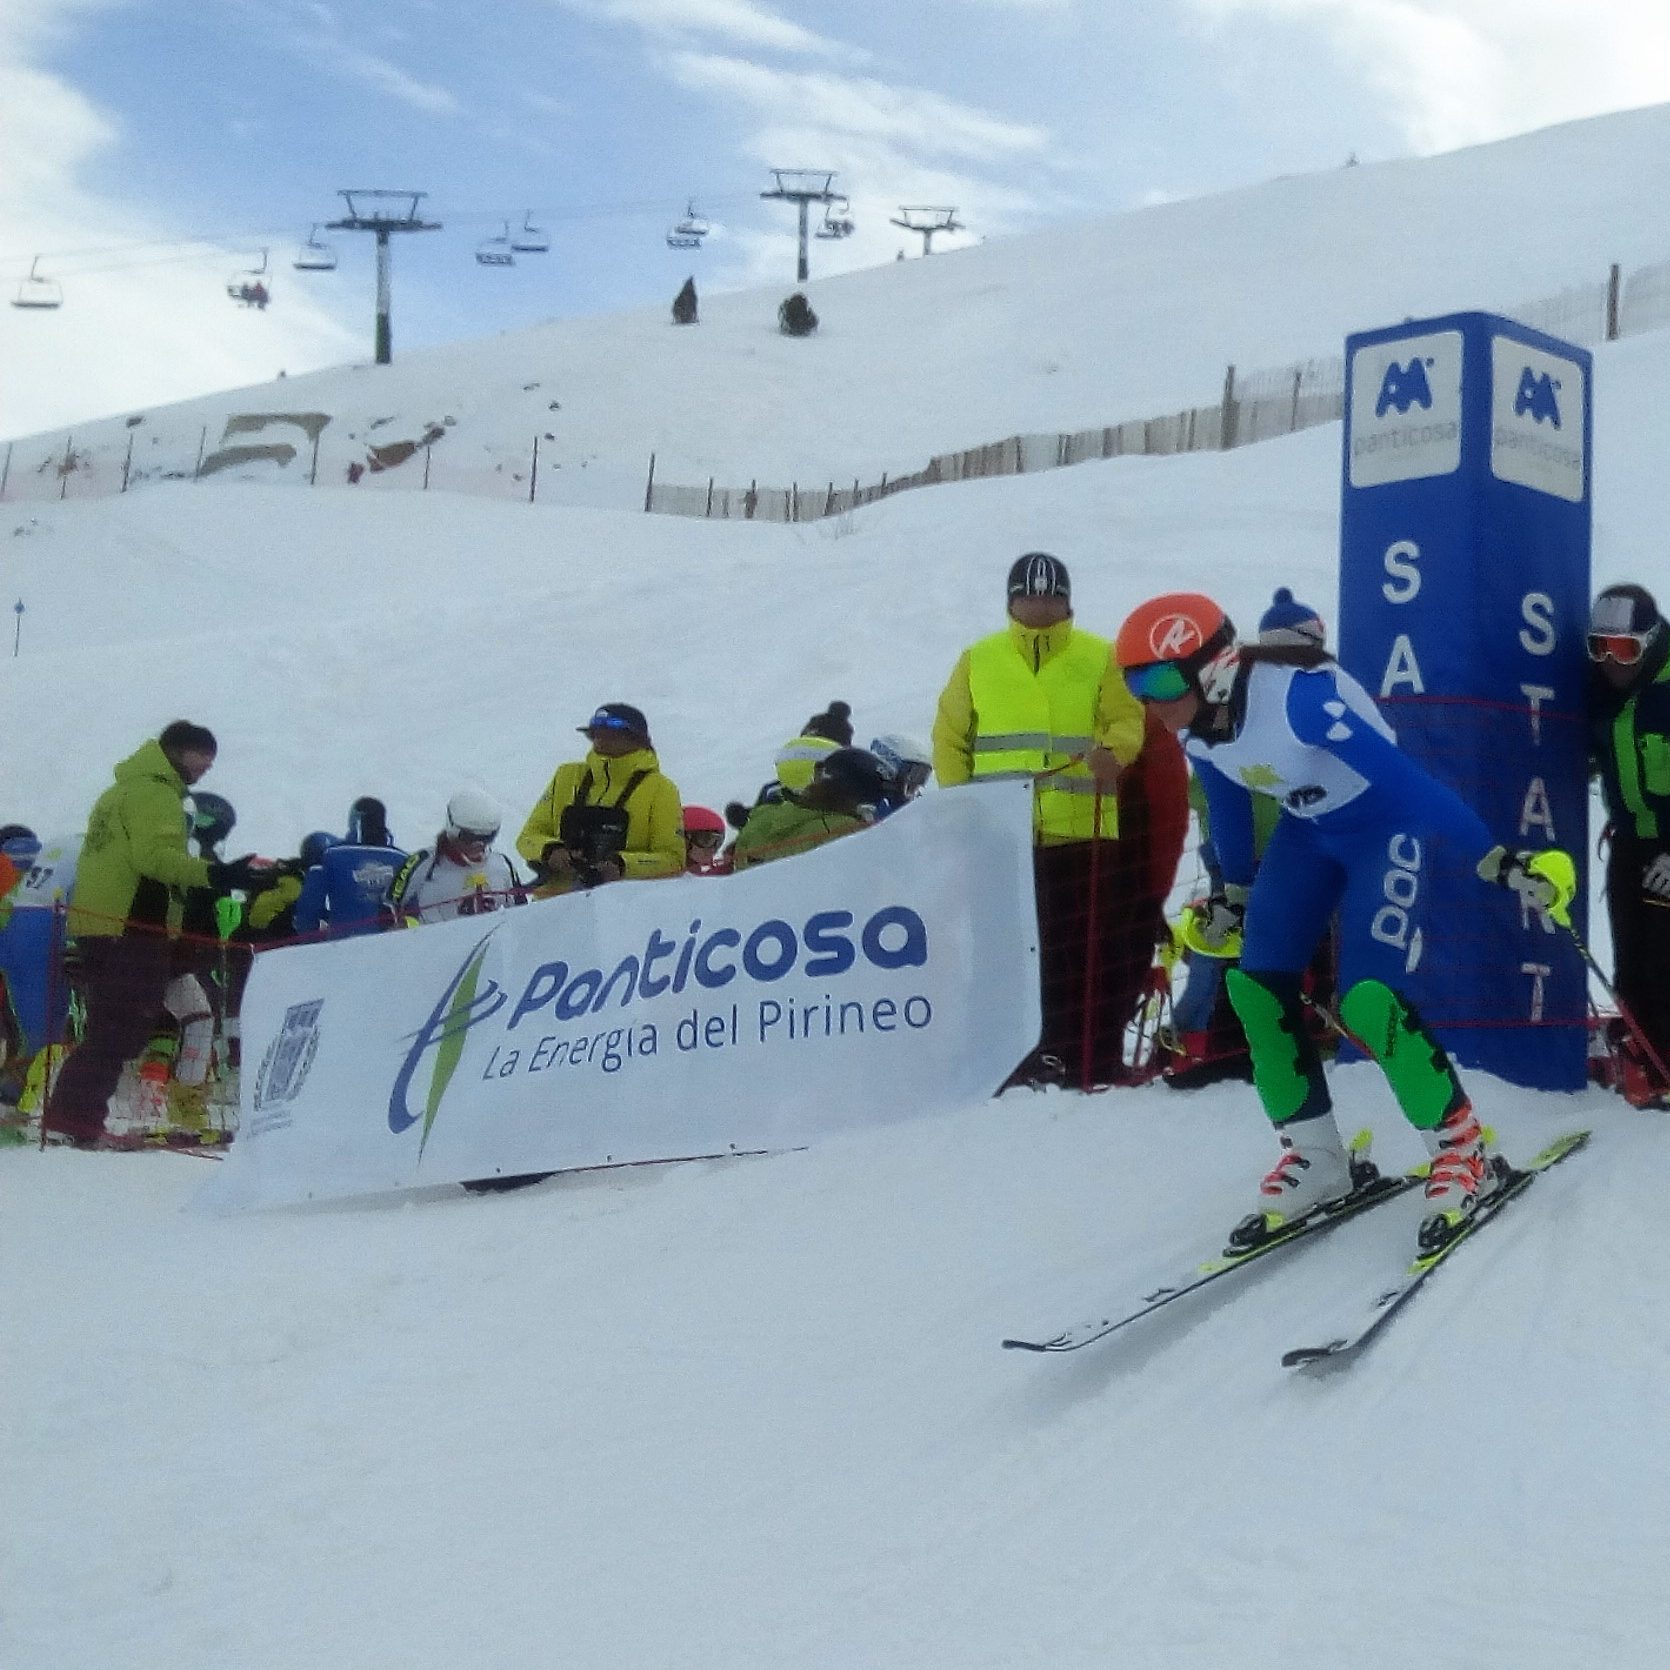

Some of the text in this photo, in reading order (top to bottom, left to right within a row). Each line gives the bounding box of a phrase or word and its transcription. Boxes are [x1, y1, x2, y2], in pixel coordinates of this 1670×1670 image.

[506, 905, 929, 1031] Panticosa
[481, 1045, 521, 1081] La
[676, 1003, 739, 1050] del
[758, 993, 933, 1044] Pirineo
